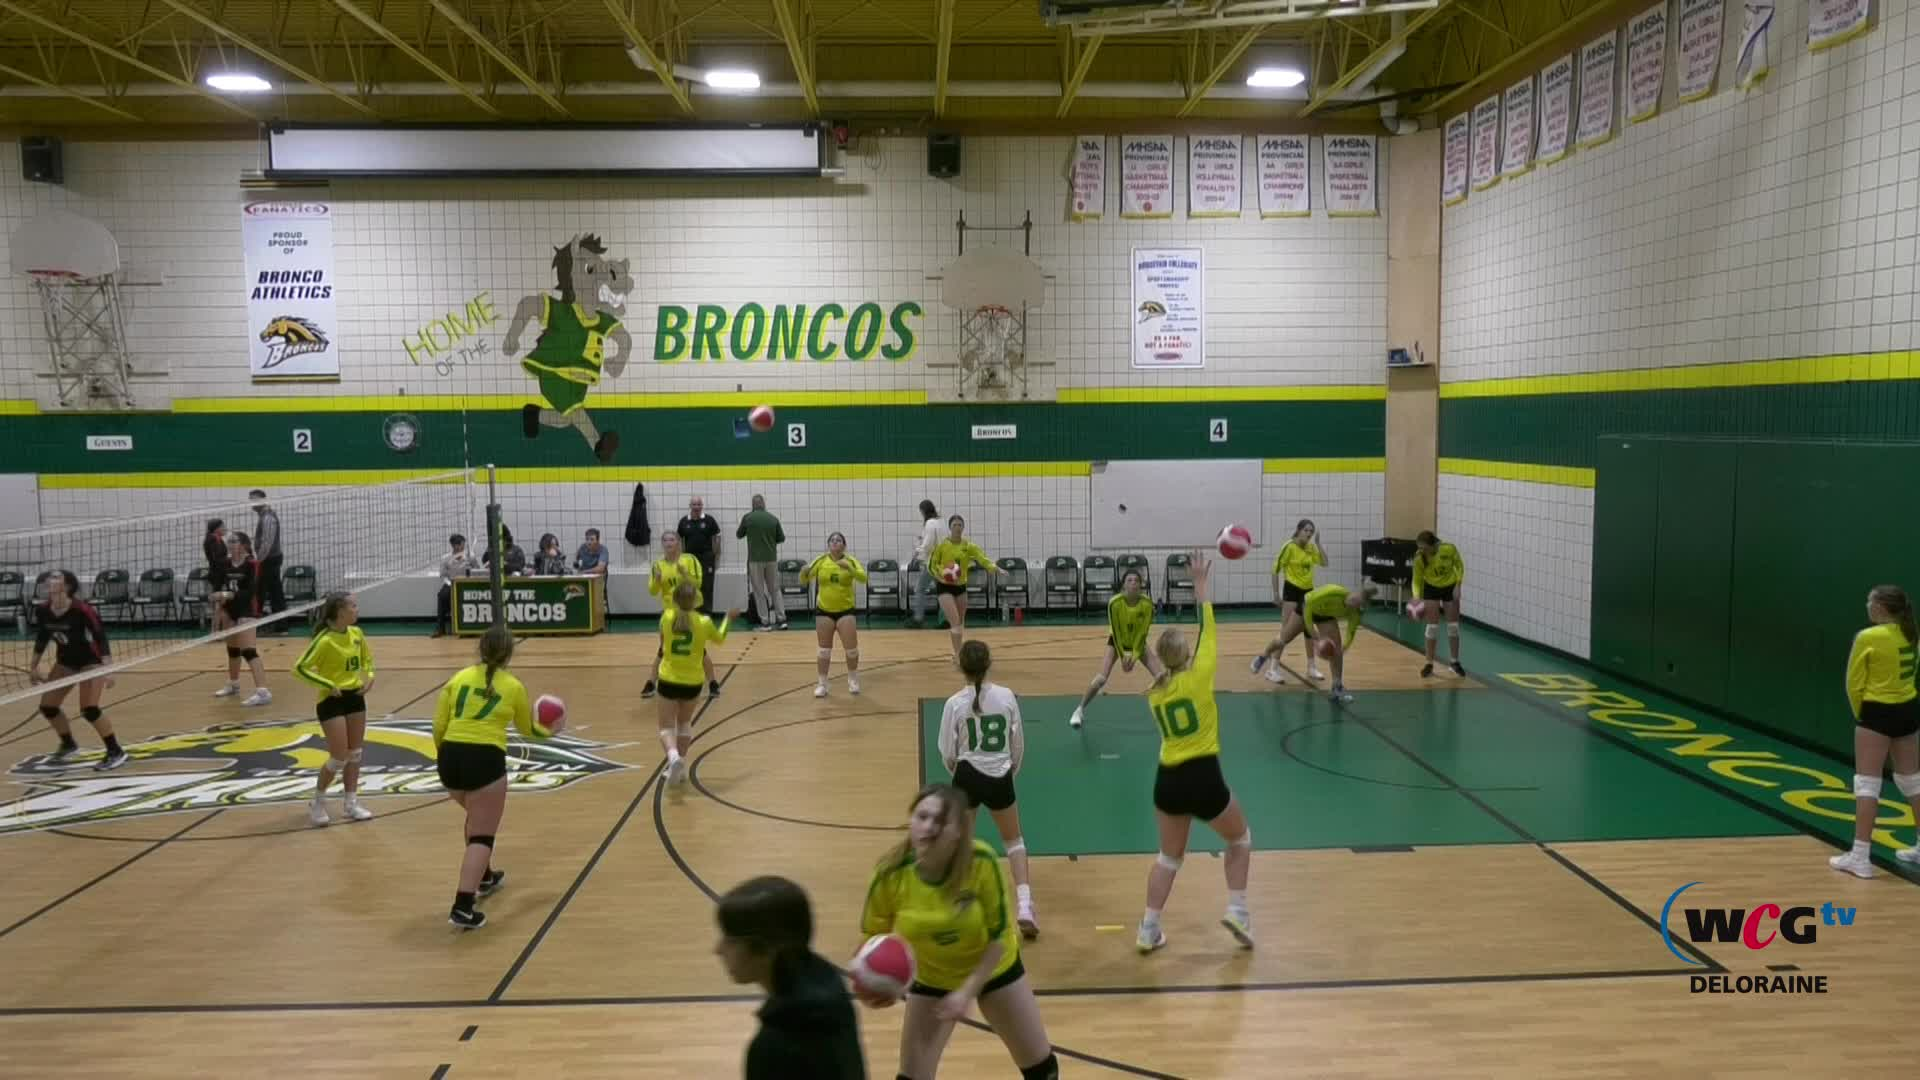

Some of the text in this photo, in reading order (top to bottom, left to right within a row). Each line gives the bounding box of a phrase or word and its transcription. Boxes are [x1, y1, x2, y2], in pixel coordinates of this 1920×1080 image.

[1126, 141, 1168, 152] MHSAA
[1194, 139, 1237, 150] MHSAA
[1261, 139, 1304, 150] MHSAA
[1328, 138, 1370, 149] MHSAA
[253, 206, 321, 216] FANATICS
[268, 239, 308, 247] SPONSOR
[258, 270, 323, 284] BRONCO
[251, 285, 332, 300] ATHLETICS
[402, 289, 502, 366] HOME
[653, 302, 923, 363] BRONCOS
[435, 338, 491, 376] OF THE
[791, 427, 803, 444] 3
[1213, 422, 1224, 439] 4
[297, 432, 309, 449] 2
[513, 588, 536, 601] THE
[462, 602, 567, 623] BRNCOS
[671, 631, 693, 656] 2
[345, 656, 360, 671] 19
[454, 685, 502, 720] 17
[1154, 698, 1199, 738] 10
[966, 714, 1007, 752] 18
